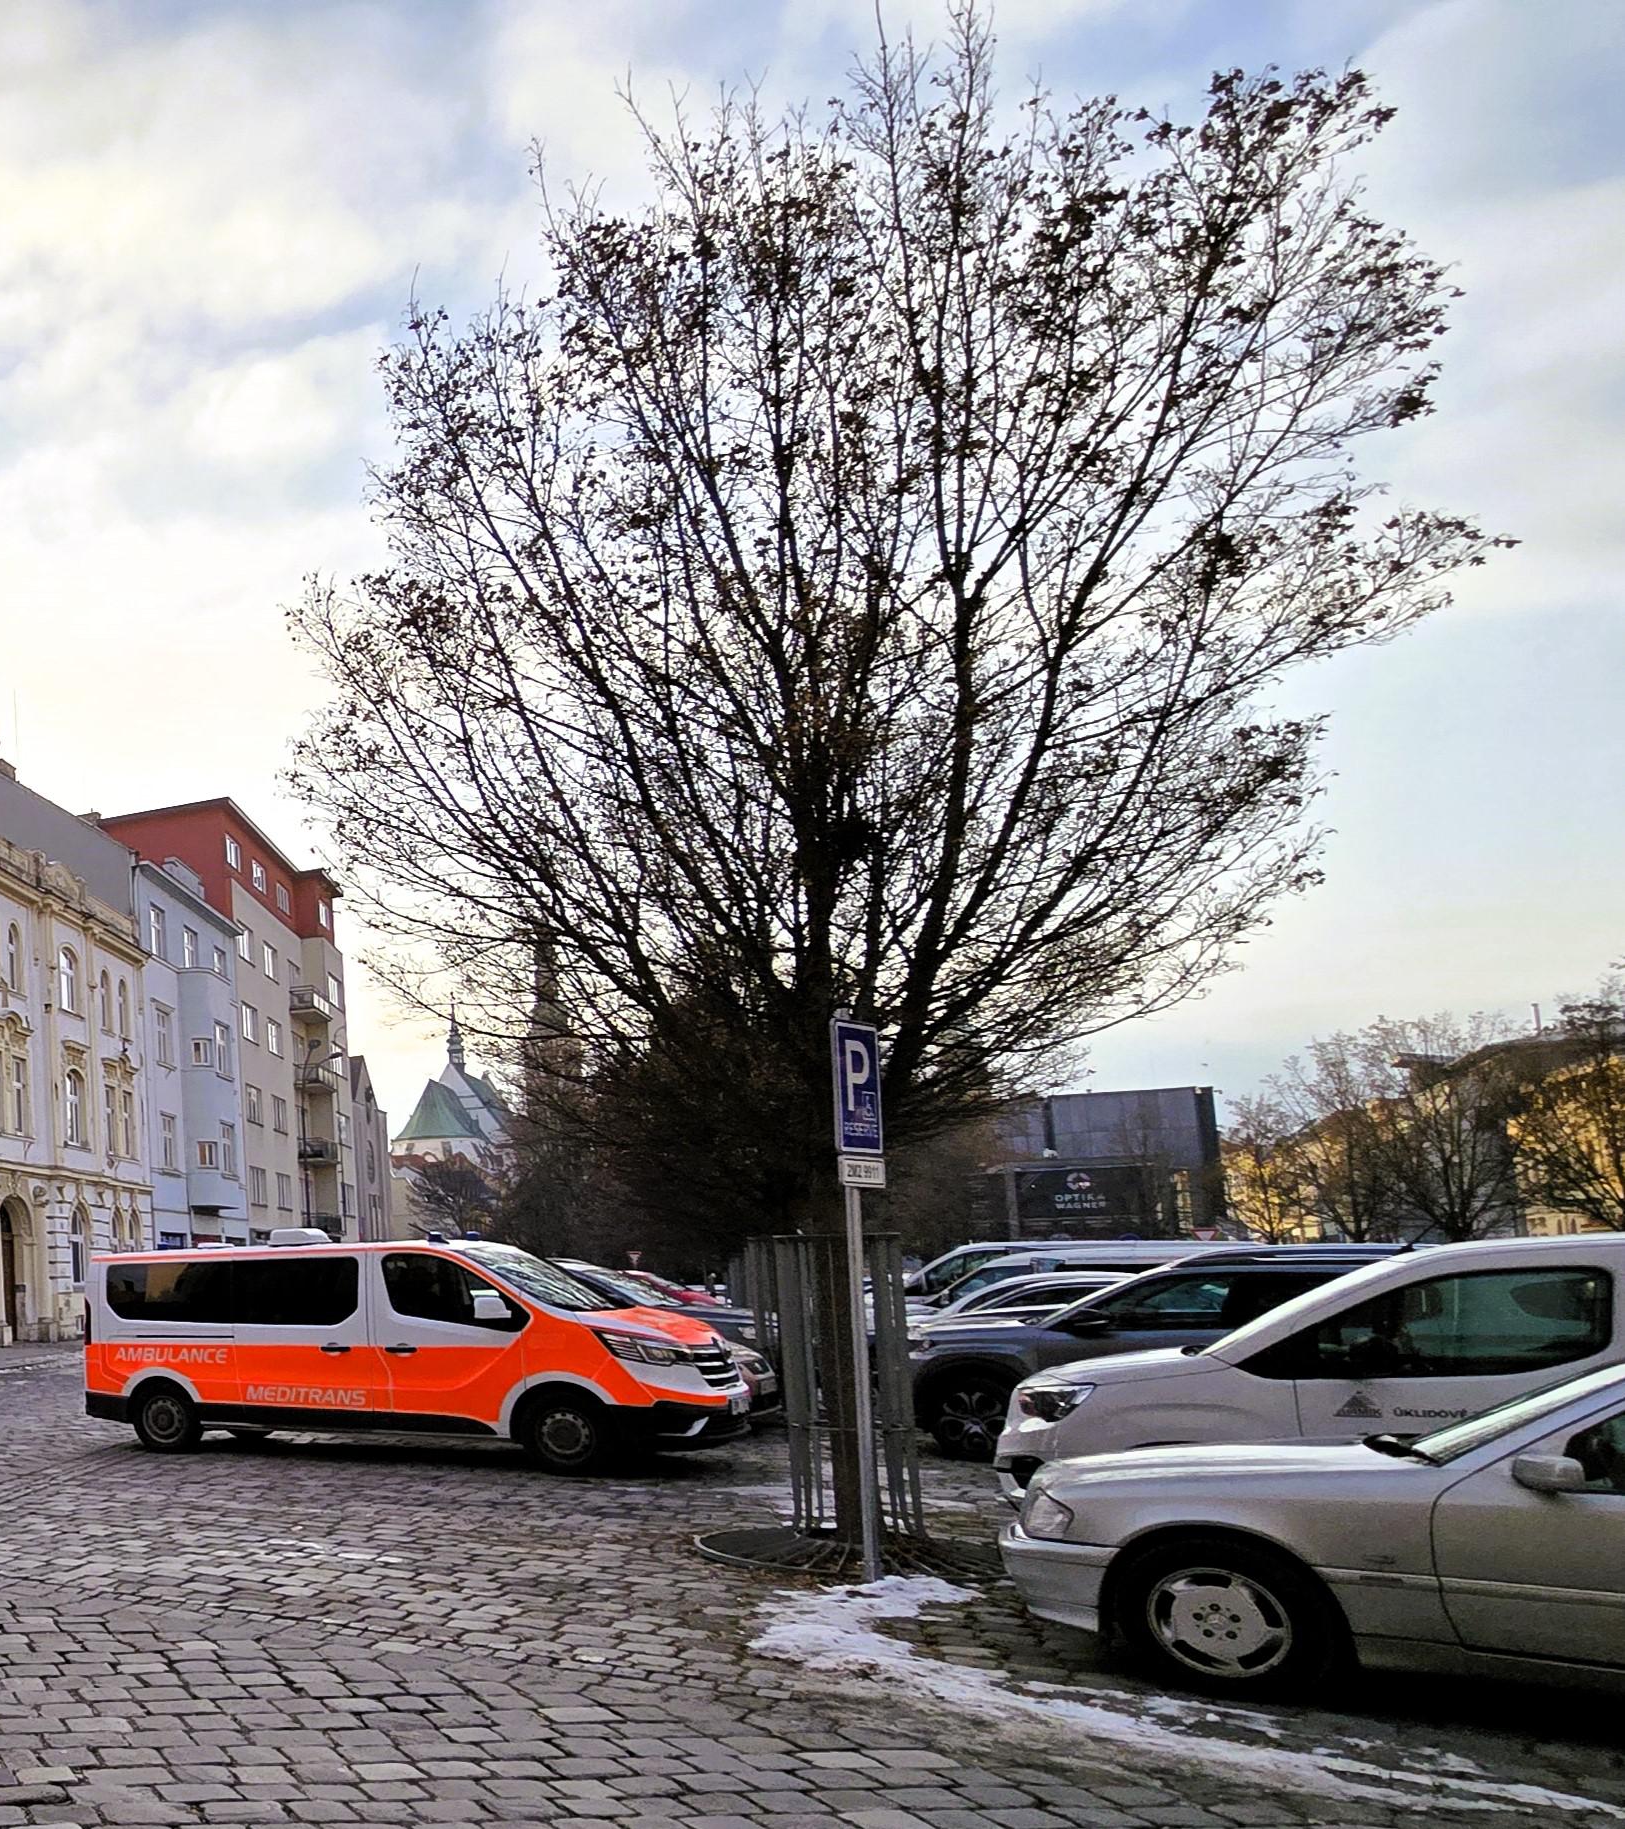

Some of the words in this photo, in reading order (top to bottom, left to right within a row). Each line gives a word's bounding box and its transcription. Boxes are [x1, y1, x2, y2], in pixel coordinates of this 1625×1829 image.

[845, 1040, 870, 1111] P
[1055, 1193, 1105, 1202] OPTIKA
[1055, 1201, 1106, 1209] WAGNER
[114, 1347, 228, 1364] AMBULANCE
[246, 1385, 367, 1406] MEDITRANS
